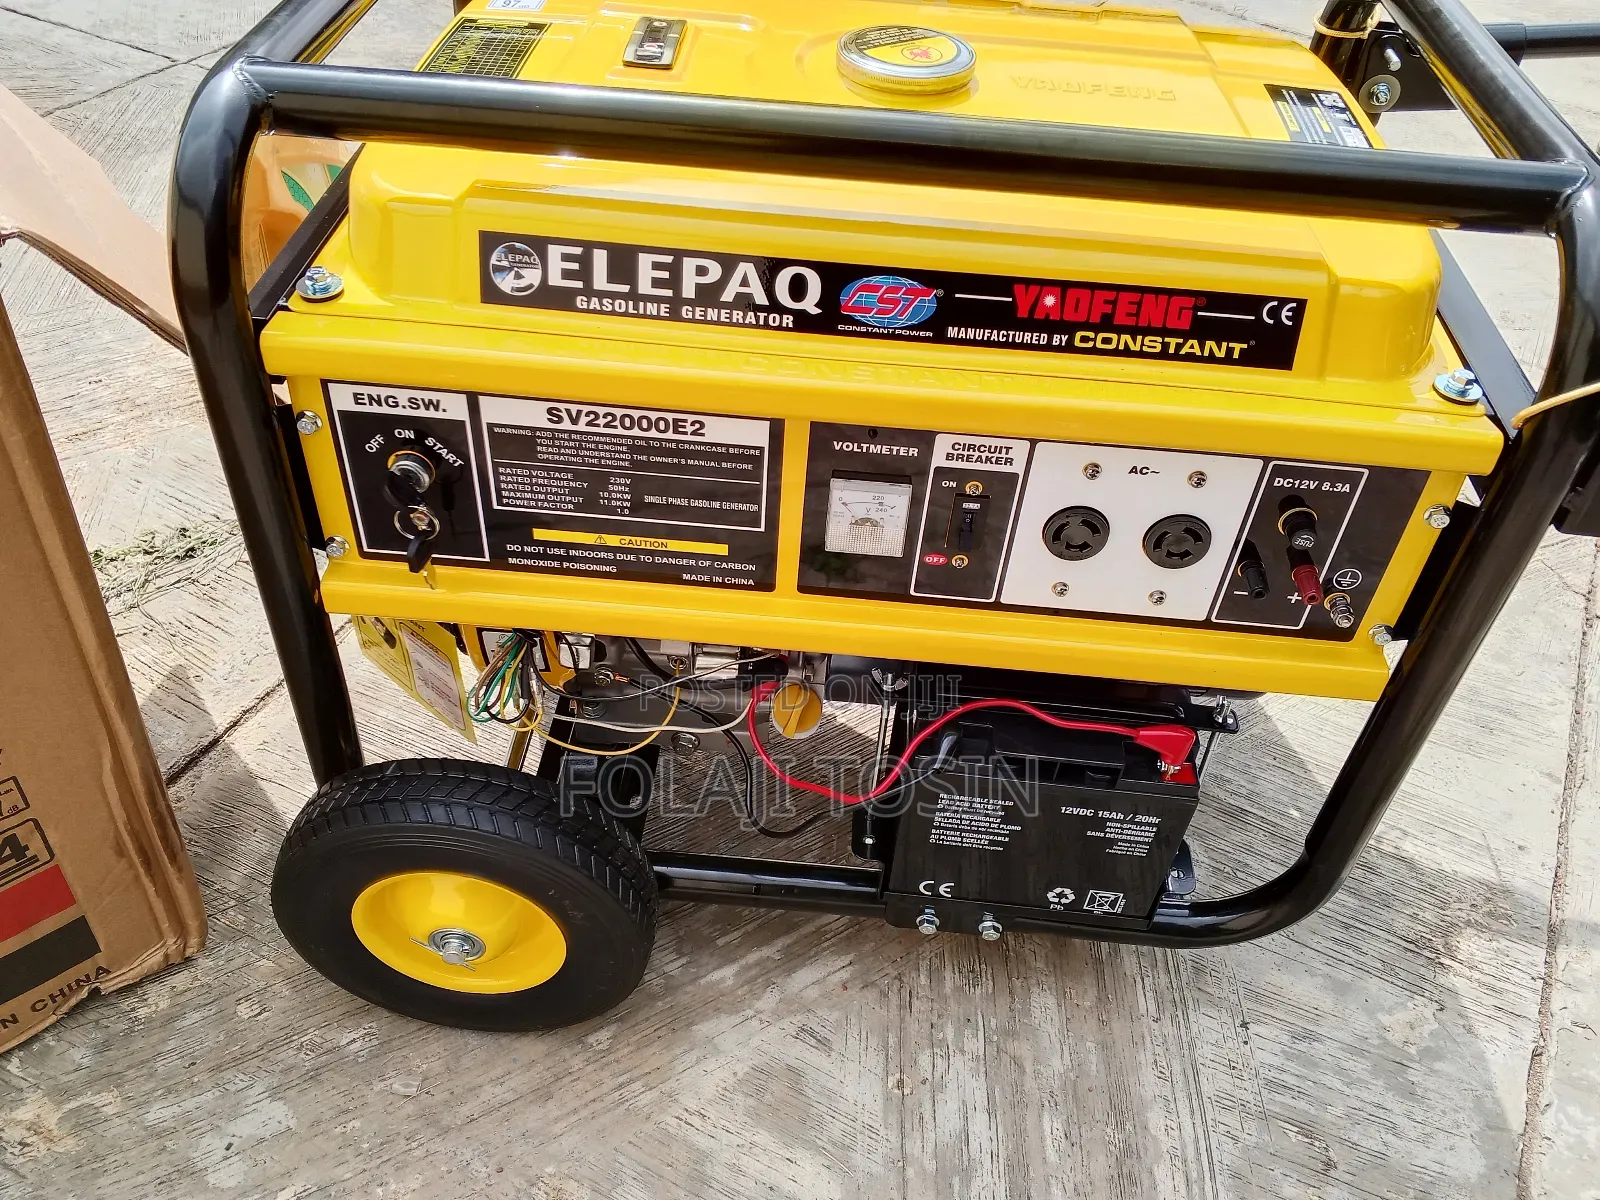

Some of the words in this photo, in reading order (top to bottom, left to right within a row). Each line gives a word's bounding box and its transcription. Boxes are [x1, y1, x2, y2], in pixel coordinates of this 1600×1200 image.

[548, 243, 822, 314] ELEPAQ
[840, 283, 936, 318] CST
[1013, 284, 1197, 330] YAOFENG
[576, 295, 670, 317] GASOLINE
[681, 305, 793, 328] GENERATOR
[838, 324, 894, 334] CONSTANT
[895, 329, 933, 337] POWER
[947, 326, 1048, 345] MANUFACTURED
[1052, 333, 1067, 346] BY
[1073, 330, 1247, 359] CONSTANT
[352, 391, 448, 413] ENG.SW.
[546, 406, 706, 438] SV22000E2
[394, 428, 415, 440] ON
[364, 434, 386, 453] OFF
[493, 427, 534, 436] WARNING:
[536, 430, 553, 438] ADD
[571, 434, 633, 445] RECOMMENDED
[678, 443, 727, 454] CRANKCASE
[729, 447, 760, 456] BEFORE
[555, 440, 580, 448] START
[598, 444, 630, 452] ENGINE.
[424, 437, 465, 468] START
[833, 440, 919, 457] VOLTMETER
[951, 441, 1013, 456] CIRCUIT
[536, 446, 559, 454] READ
[578, 450, 632, 460] UNDERSTAND
[633, 454, 648, 462] THE
[650, 456, 686, 465] OWNER'S
[688, 459, 720, 468] MANUAL
[722, 462, 754, 470] BEFORE
[538, 454, 583, 463] OPERATING
[584, 457, 600, 465] THE
[601, 459, 632, 468] ENGINE.
[945, 452, 1014, 466] BREAKER
[498, 468, 530, 476] RATED
[532, 470, 574, 480] VOLTAGE
[610, 476, 631, 484] 230V
[500, 475, 530, 484] RATED
[532, 478, 588, 488] FREQUENCY
[608, 484, 630, 492] 50Hz
[942, 480, 957, 488] ON
[1273, 477, 1319, 490] DC12V
[1322, 482, 1351, 493] 8.3A
[500, 483, 531, 491] RATED
[533, 485, 570, 494] OUTPUT
[501, 490, 545, 500] MAXIMUM
[547, 494, 584, 504] OUTPUT
[599, 492, 631, 500] 10.0KW
[502, 498, 536, 507] POWER
[538, 502, 574, 510] FACTOR
[599, 500, 631, 508] 11.0KW
[644, 495, 667, 504] SINGLE
[668, 497, 689, 506] PHASE
[690, 499, 721, 509] GASOLINE
[722, 502, 759, 512] GENERATOR
[619, 538, 668, 549] CAUTION
[1295, 538, 1314, 548] FUSE
[506, 544, 522, 552] DO
[524, 546, 544, 554] NOT
[546, 548, 568, 556] USE
[568, 550, 614, 560] INDOORS
[616, 553, 637, 561] DUE
[639, 554, 652, 562] TO
[654, 556, 696, 566] DANGER
[698, 560, 712, 568] OF
[714, 561, 756, 571] CARBON
[508, 557, 561, 568] MONOXIDE
[562, 562, 618, 573] POISONING
[682, 573, 710, 582] MADE
[724, 576, 754, 586] CHINA
[940, 794, 988, 804] RECHARGEABLE
[989, 798, 1014, 806] SEALED
[972, 802, 1000, 810] BATTERY
[8, 804, 19, 814] dB
[1060, 806, 1095, 816] 12VDC
[1097, 810, 1124, 820] 15Ah
[1134, 814, 1162, 824] 20Hr
[934, 816, 960, 824] SELLADA
[962, 814, 1002, 822] RECARGABLE
[1105, 828, 1156, 838] ANTI-DERRAME
[1106, 822, 1158, 832] NON-SPILLABLE
[962, 832, 1010, 842] RECHARGEABLE
[0, 1013, 20, 1030] N
[30, 966, 112, 1012] CHINA
